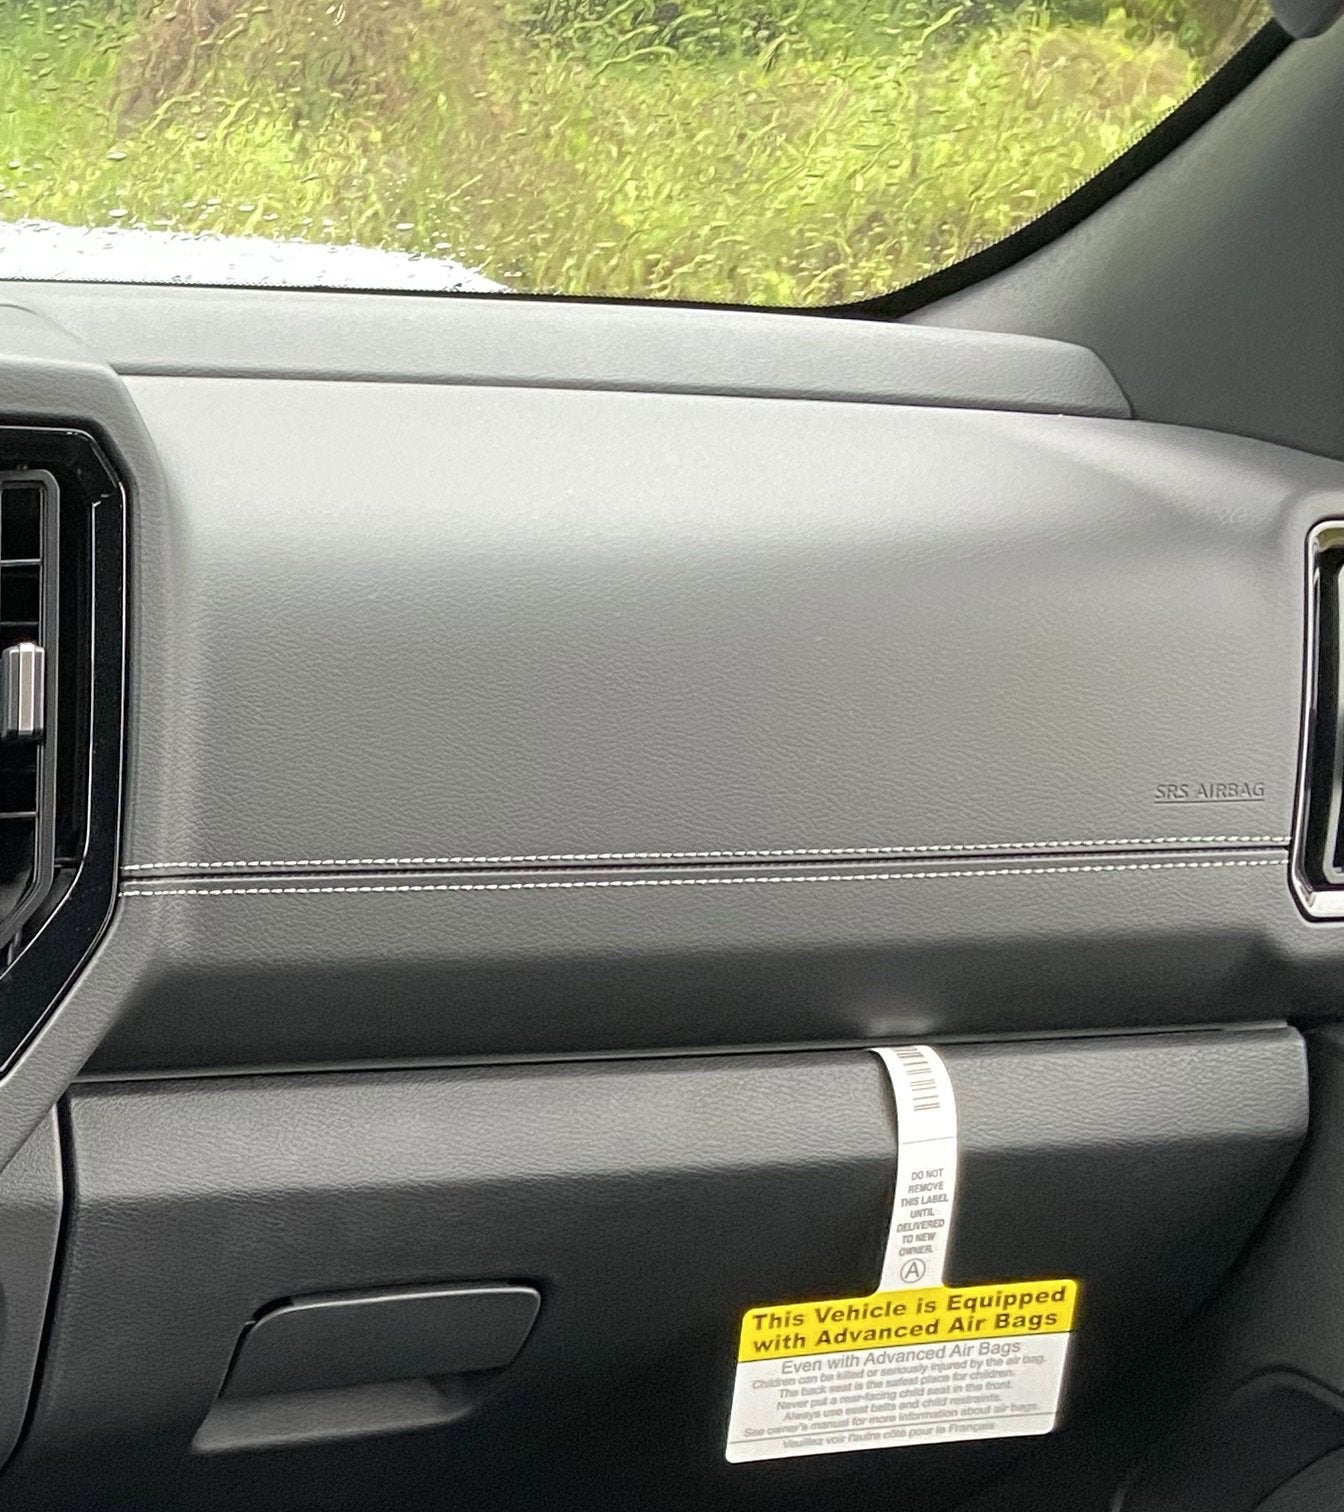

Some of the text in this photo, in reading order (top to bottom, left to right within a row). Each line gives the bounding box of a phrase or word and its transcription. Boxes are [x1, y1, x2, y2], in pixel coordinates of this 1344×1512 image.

[1155, 781, 1265, 800] SRS AIRBAG
[911, 1168, 945, 1181] DO NOT
[908, 1181, 944, 1194] REMOVE
[901, 1194, 949, 1207] THIS LABEL
[910, 1208, 935, 1218] UNTIL
[896, 1219, 945, 1233] DELIVERED
[902, 1232, 936, 1245] TO NEW
[752, 1284, 1067, 1331] This Vehicle is Equipped
[753, 1312, 1058, 1353] with Advanced Air Bags
[781, 1341, 1022, 1375] Even with Advanced Air Bags
[866, 1369, 878, 1377] or
[970, 1358, 984, 1370] by
[985, 1357, 1004, 1367] the
